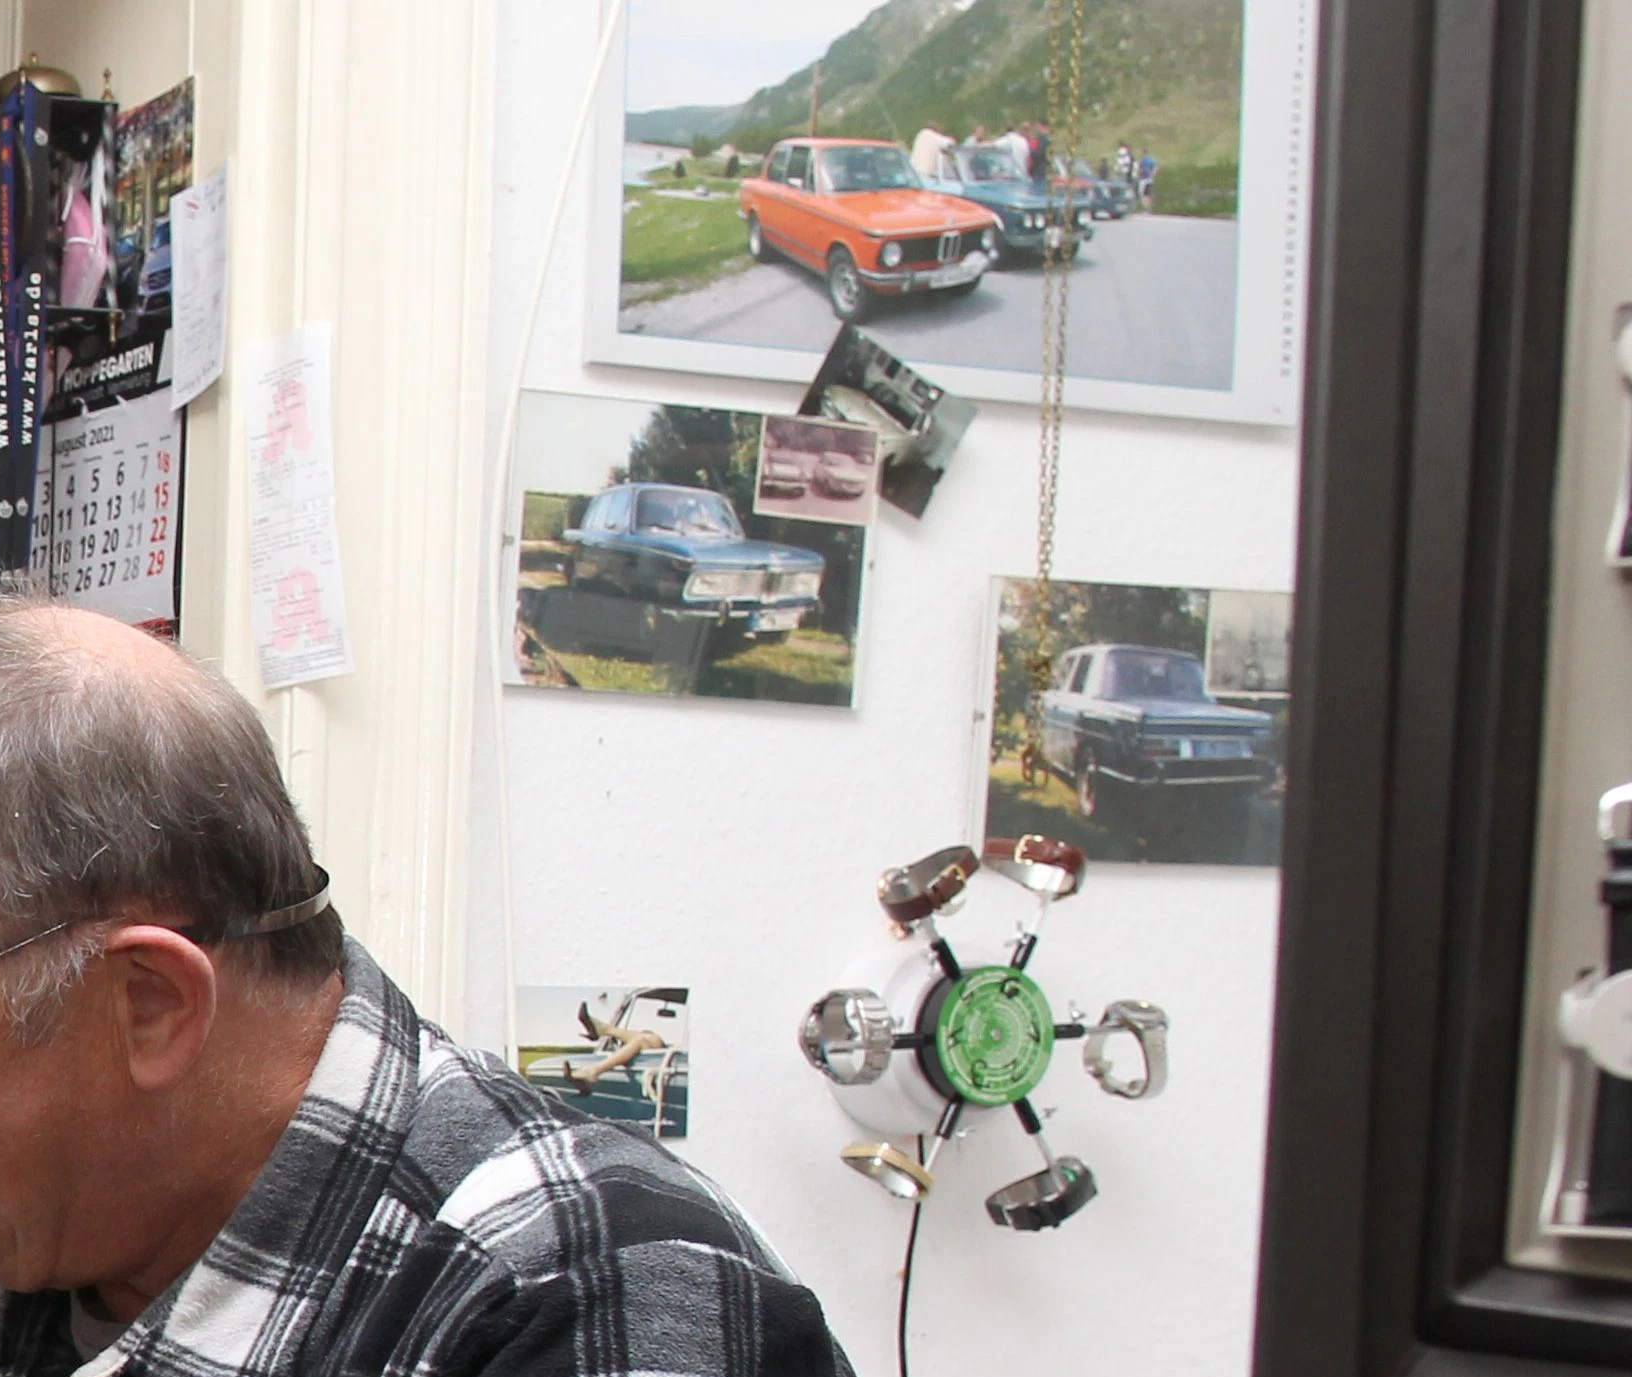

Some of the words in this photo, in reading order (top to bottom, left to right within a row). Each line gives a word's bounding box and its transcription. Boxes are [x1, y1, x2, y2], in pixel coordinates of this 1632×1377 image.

[89, 425, 115, 446] 2021
[42, 481, 51, 505] 3
[65, 474, 75, 499] 4
[90, 468, 101, 493] 5
[116, 461, 125, 486] 6
[140, 455, 149, 480] 7
[33, 513, 50, 538] 10
[56, 508, 73, 532] 11
[81, 501, 97, 526] 12
[106, 495, 122, 521] 13
[130, 489, 146, 515] 14
[154, 481, 169, 509] 15
[31, 545, 48, 570] 17
[55, 539, 72, 565] 18
[80, 533, 96, 560] 19
[102, 528, 119, 555] 20
[125, 522, 142, 549] 21
[150, 515, 168, 543] 22
[74, 568, 92, 593] 26
[98, 561, 116, 588] 27
[122, 556, 140, 582] 28
[146, 549, 165, 577] 29
